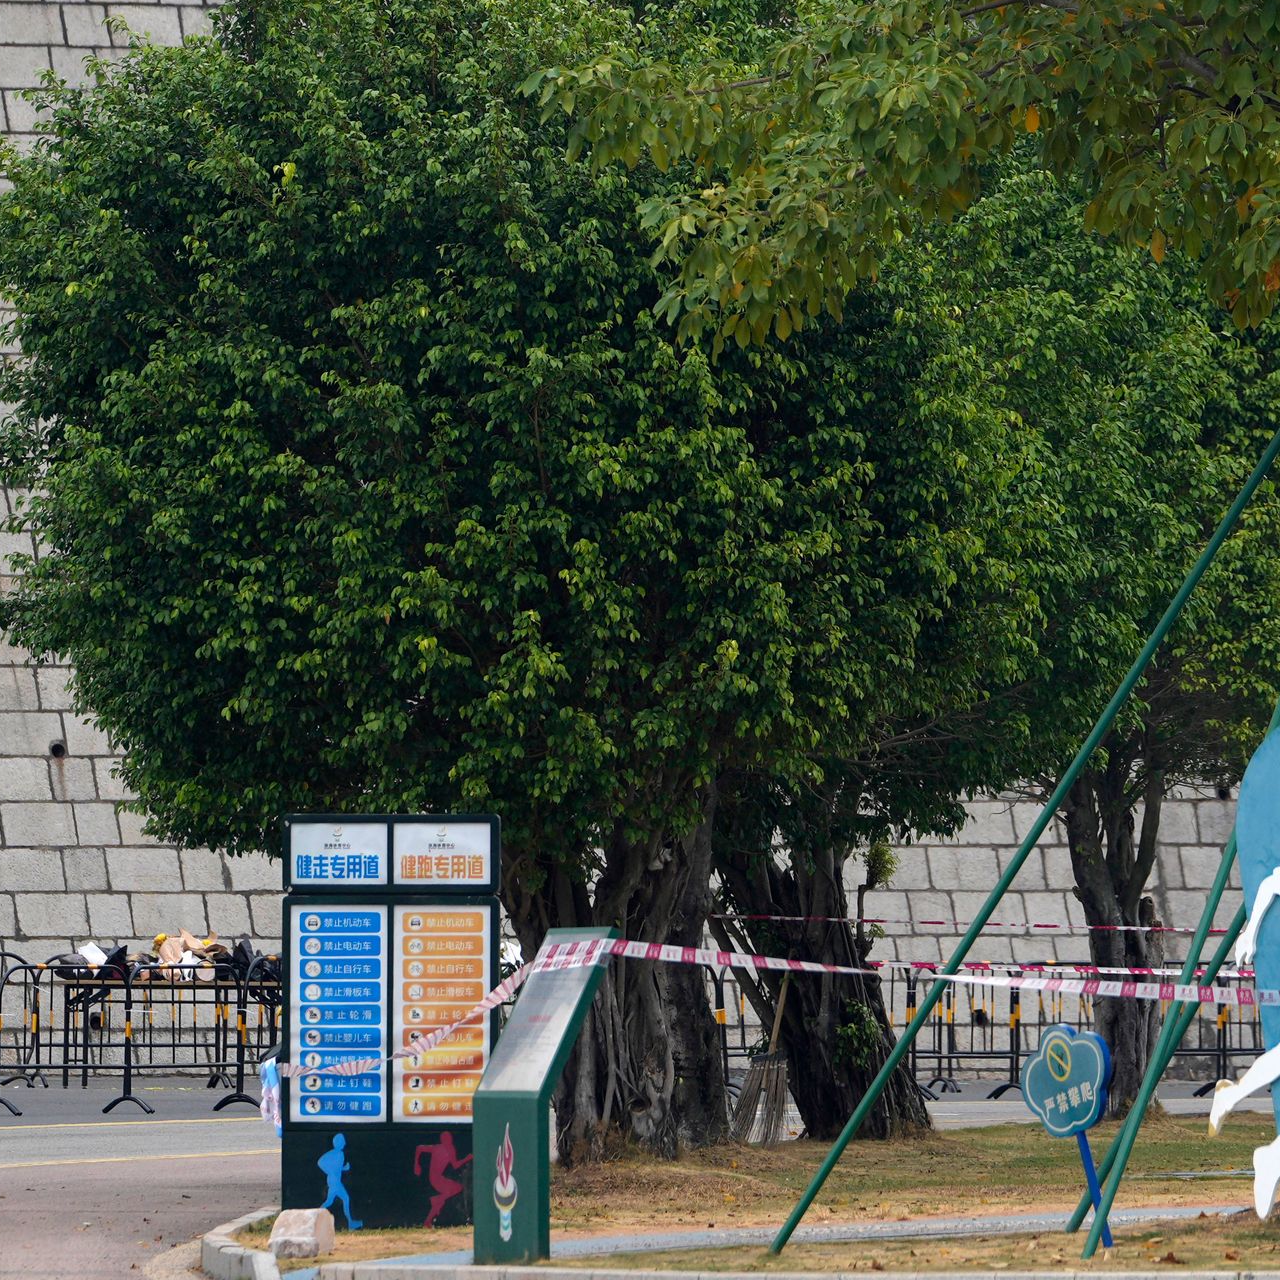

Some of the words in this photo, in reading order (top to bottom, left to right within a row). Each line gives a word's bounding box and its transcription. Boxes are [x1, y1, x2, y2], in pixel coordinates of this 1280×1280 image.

[296, 854, 379, 880] 健走专用道
[400, 854, 484, 880] 健跑专用道
[323, 918, 372, 928] 禁止机动车
[426, 918, 475, 928] 禁止机动车
[323, 941, 372, 951] 禁止电动车
[426, 941, 475, 951] 禁止电动车
[323, 964, 372, 974] 禁止自行车
[426, 964, 475, 974] 禁止自行车
[323, 987, 372, 997] 禁止滑板车
[426, 987, 475, 997] 禁止滑板车
[323, 1010, 372, 1020] 禁止轮滑
[323, 1033, 372, 1043] 禁止婴儿车
[323, 1078, 372, 1088] 禁止钉鞋
[426, 1078, 475, 1088] 禁止钉鞋
[1044, 1081, 1094, 1119] 严禁攀爬
[323, 1101, 372, 1111] 请勿健跑
